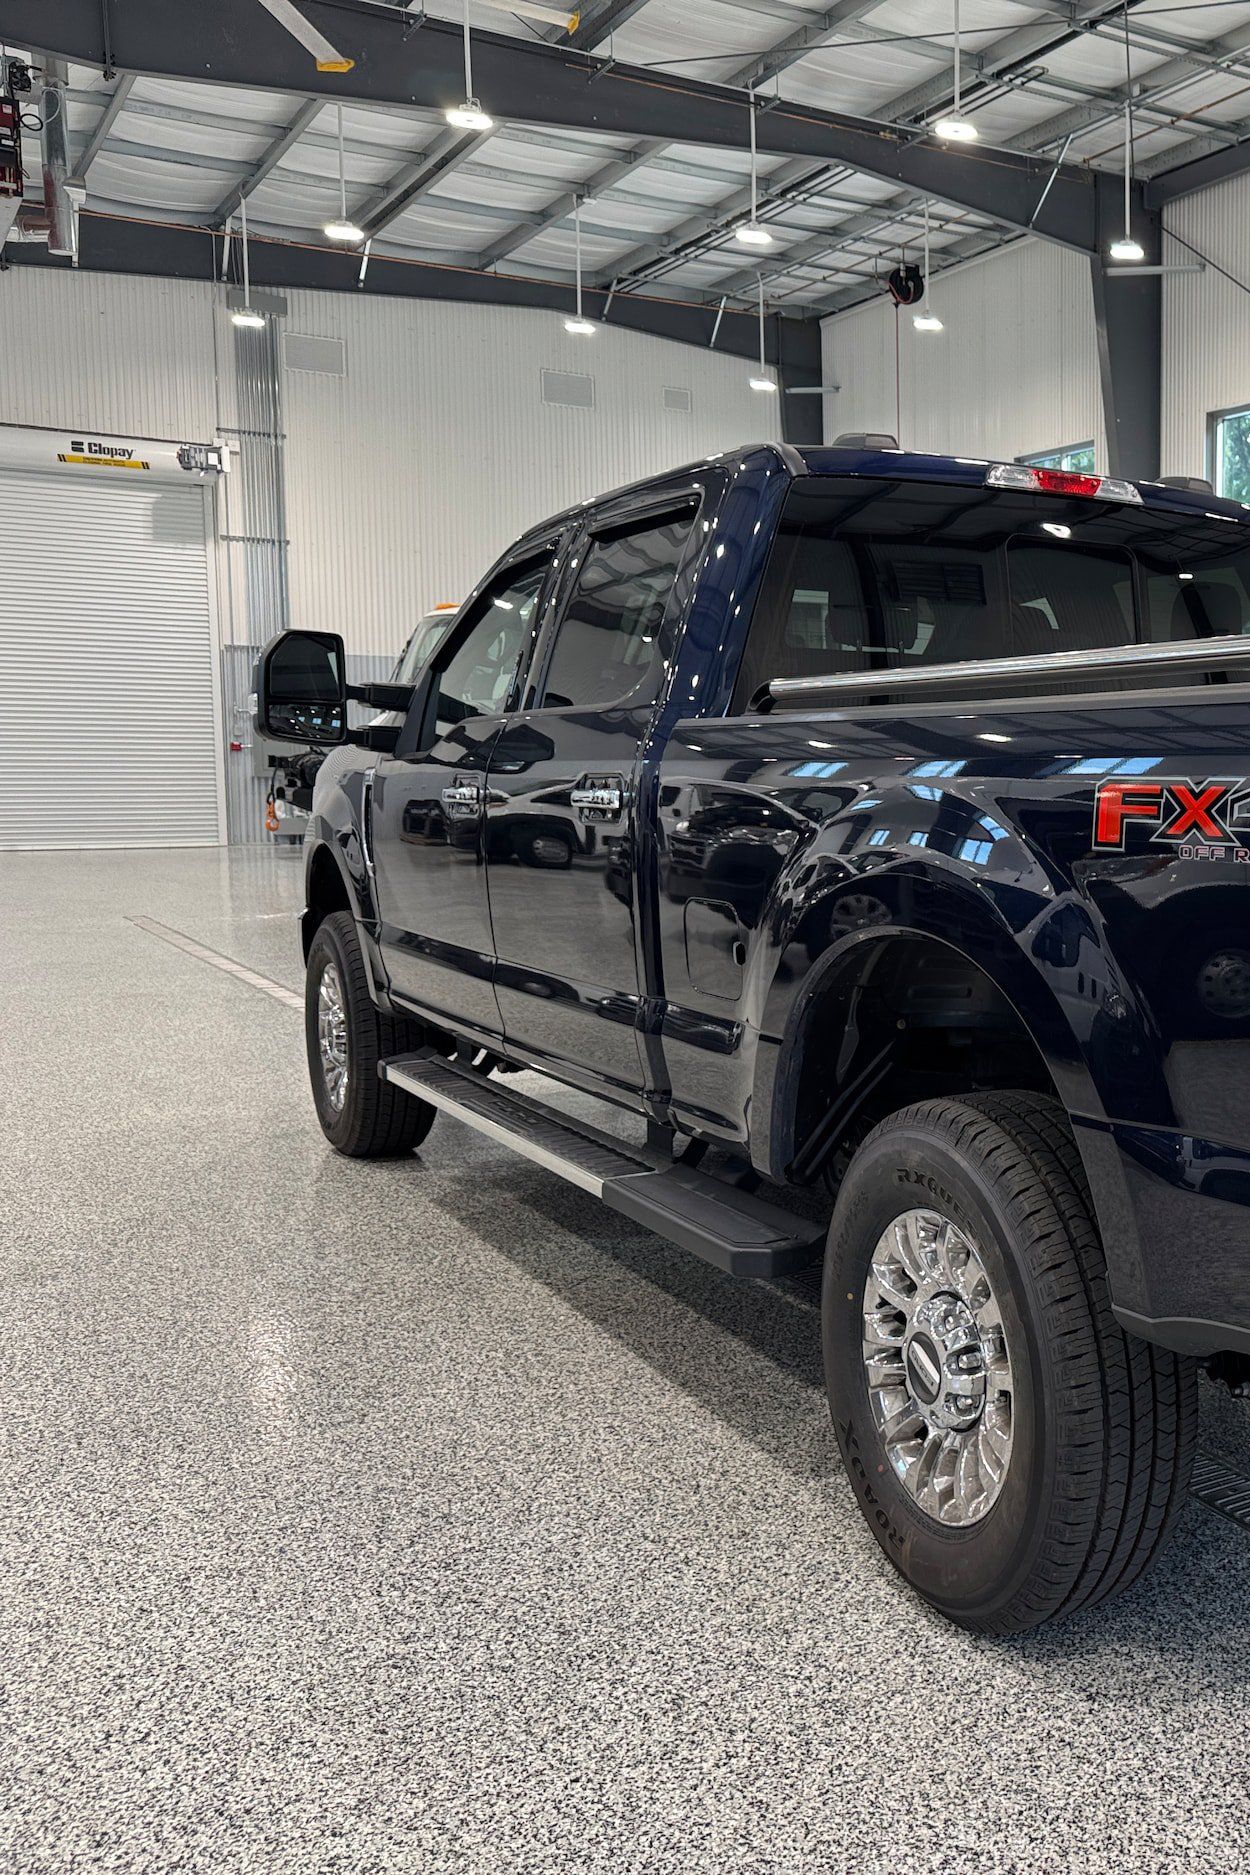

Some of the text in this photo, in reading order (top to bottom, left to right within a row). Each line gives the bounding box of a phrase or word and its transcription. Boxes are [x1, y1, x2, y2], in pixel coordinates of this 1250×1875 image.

[87, 442, 134, 460] Clopay
[1178, 845, 1226, 861] OFF
[834, 1416, 905, 1548] ROADX
